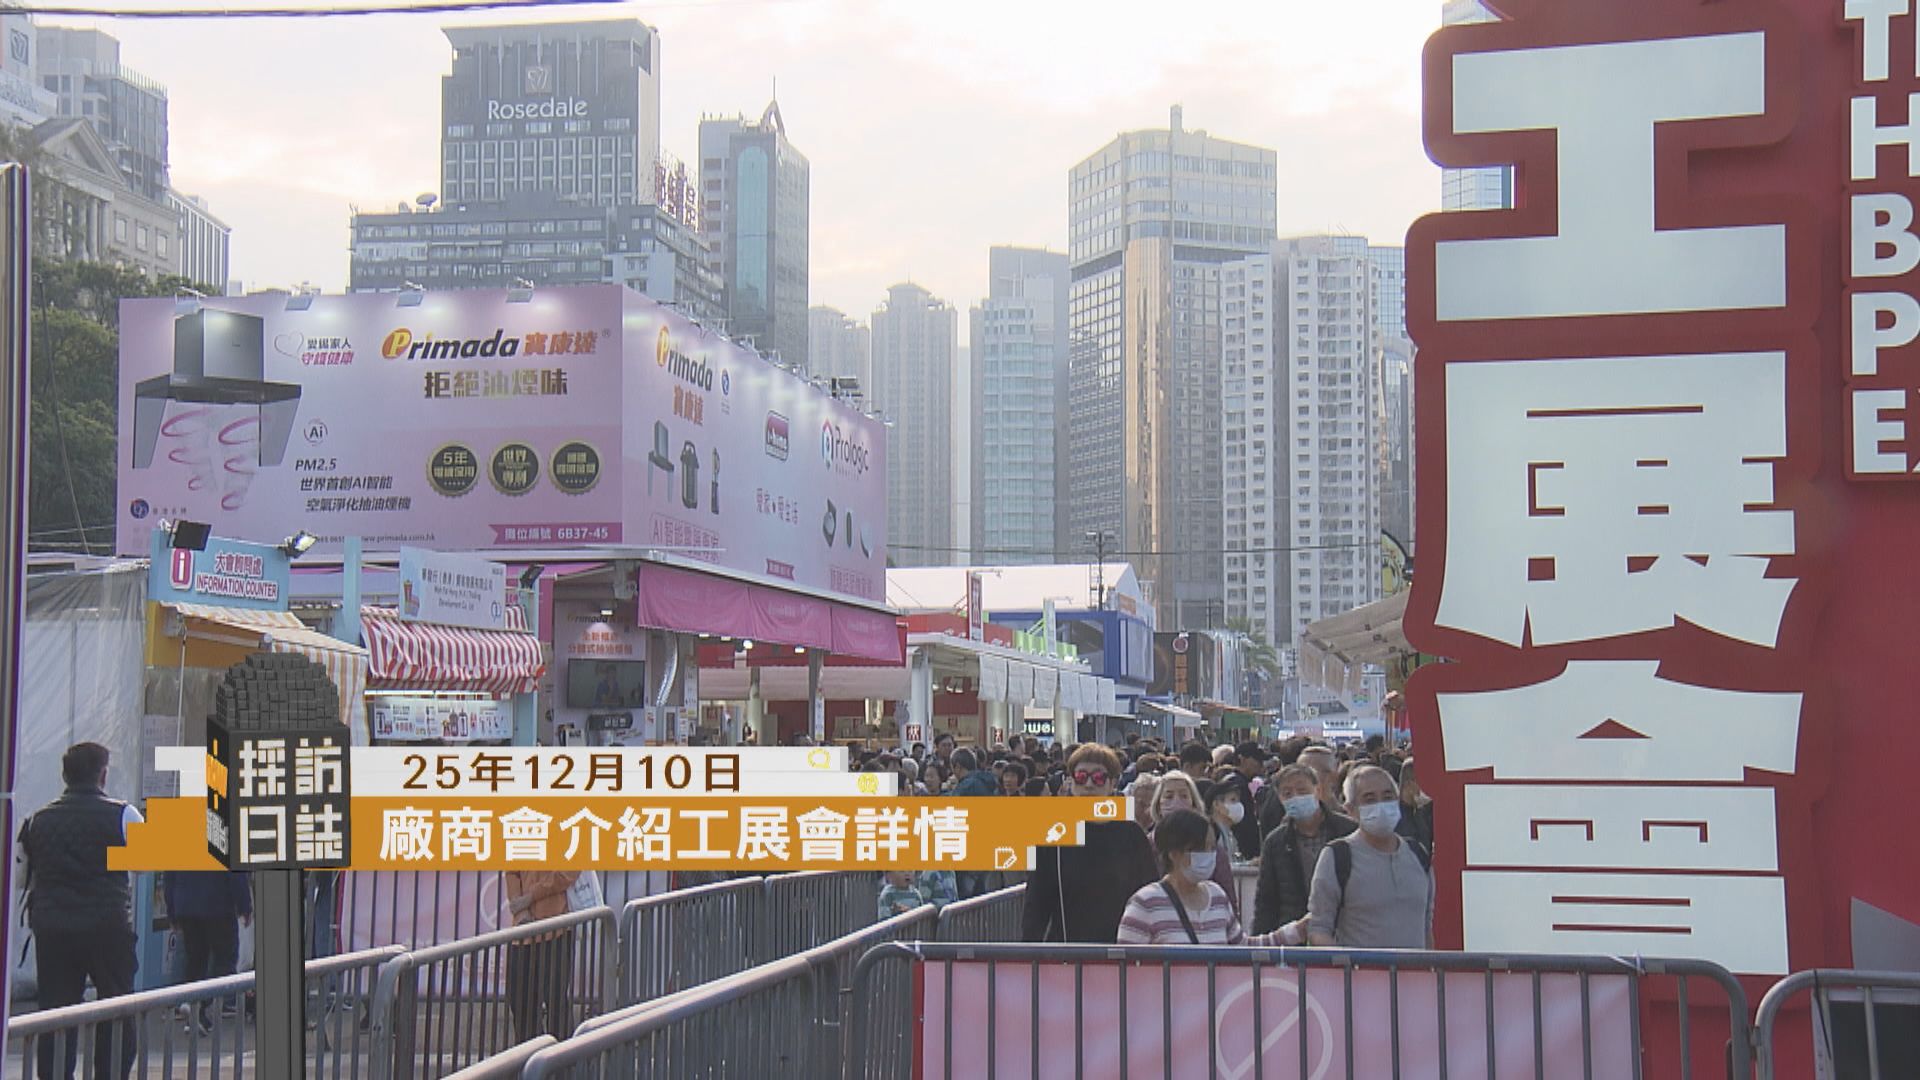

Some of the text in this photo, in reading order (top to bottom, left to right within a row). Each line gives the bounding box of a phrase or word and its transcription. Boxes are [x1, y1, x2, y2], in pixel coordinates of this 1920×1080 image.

[487, 96, 588, 119] Rosedale
[382, 327, 520, 360] Primada
[656, 325, 713, 392] Primada
[425, 367, 568, 399] 拒絕油煙味
[443, 452, 468, 465] 5年
[835, 425, 869, 475] Prologic
[295, 458, 337, 471] PM2.5
[1434, 31, 1804, 975] 工展會
[361, 532, 435, 545] ww.primada.com.hk
[557, 527, 608, 539] 6B37-45
[196, 575, 277, 597] INFORMATION COUNTER
